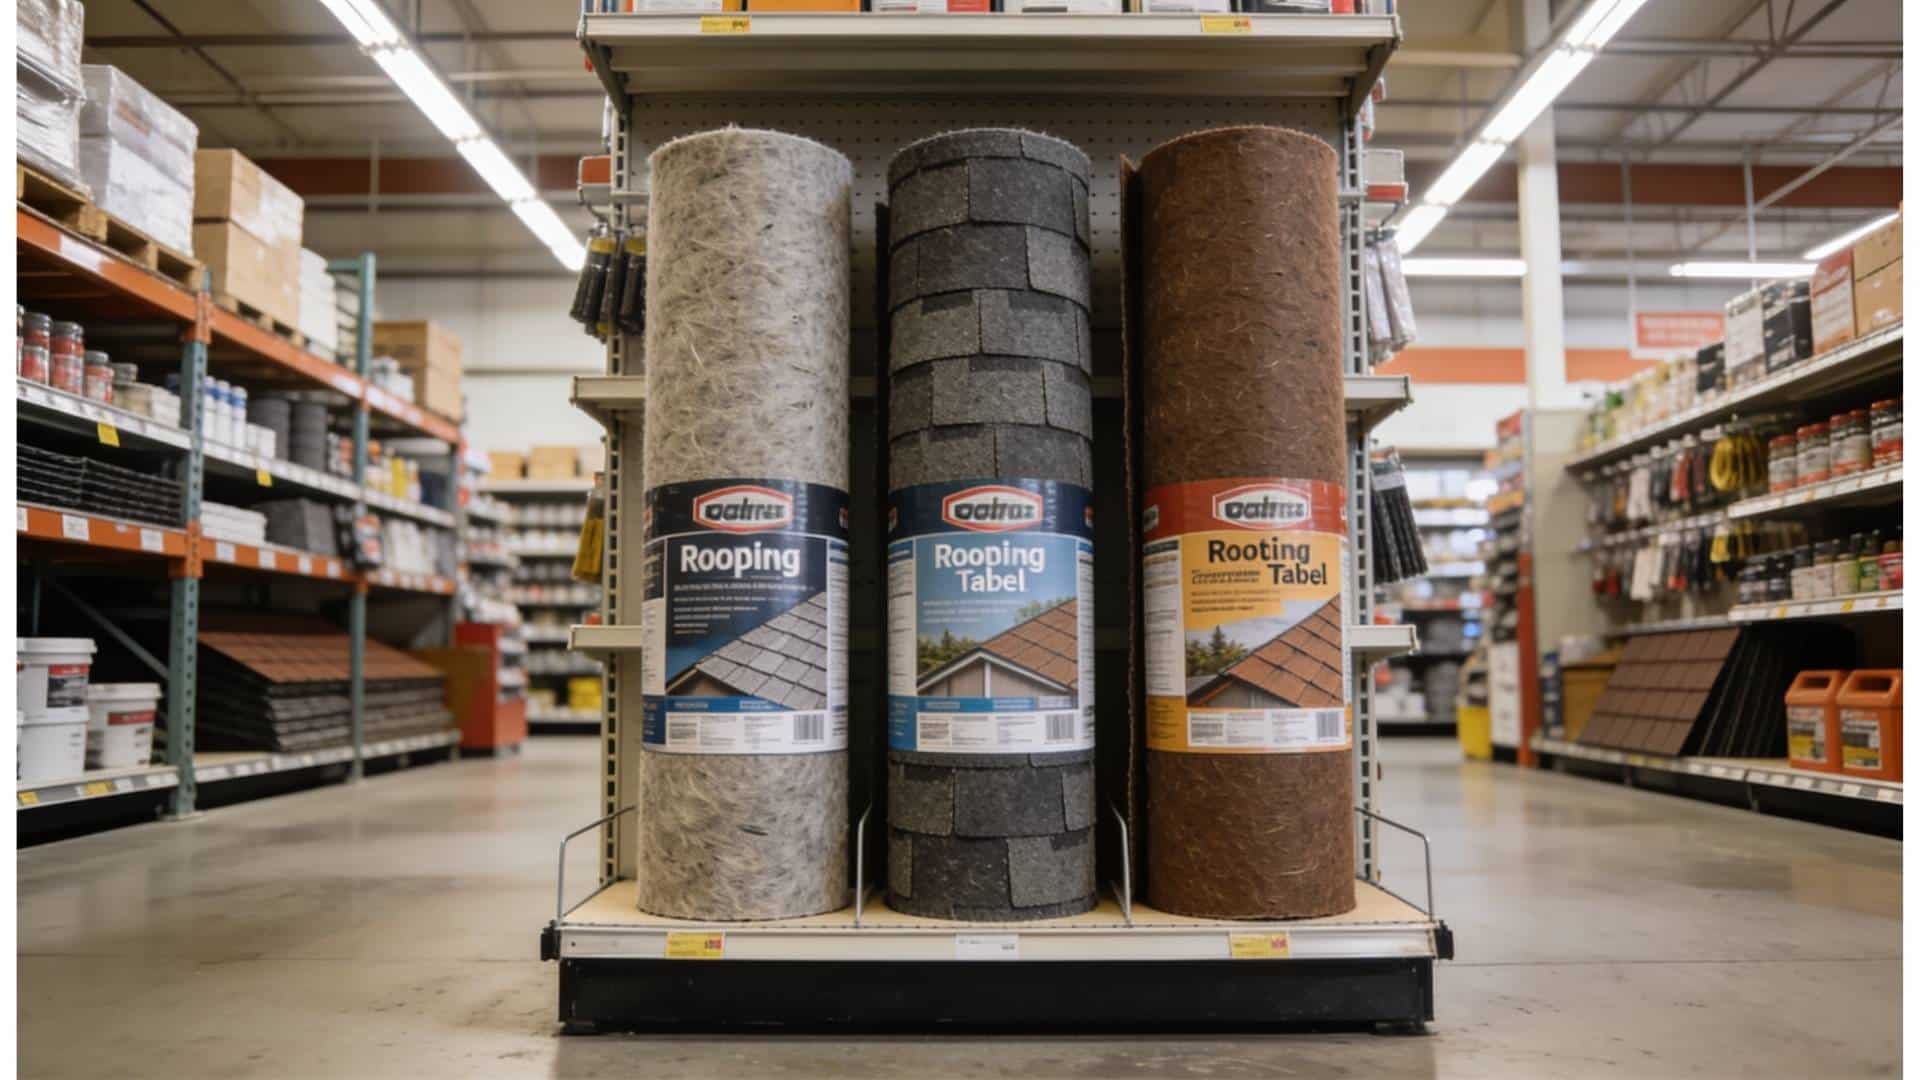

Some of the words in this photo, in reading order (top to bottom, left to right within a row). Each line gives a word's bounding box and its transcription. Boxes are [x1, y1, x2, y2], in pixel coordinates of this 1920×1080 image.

[680, 541, 800, 578] Rooping
[1208, 537, 1311, 565] Rooting
[956, 567, 1026, 593] Tabel
[1267, 563, 1328, 585] Tabel
